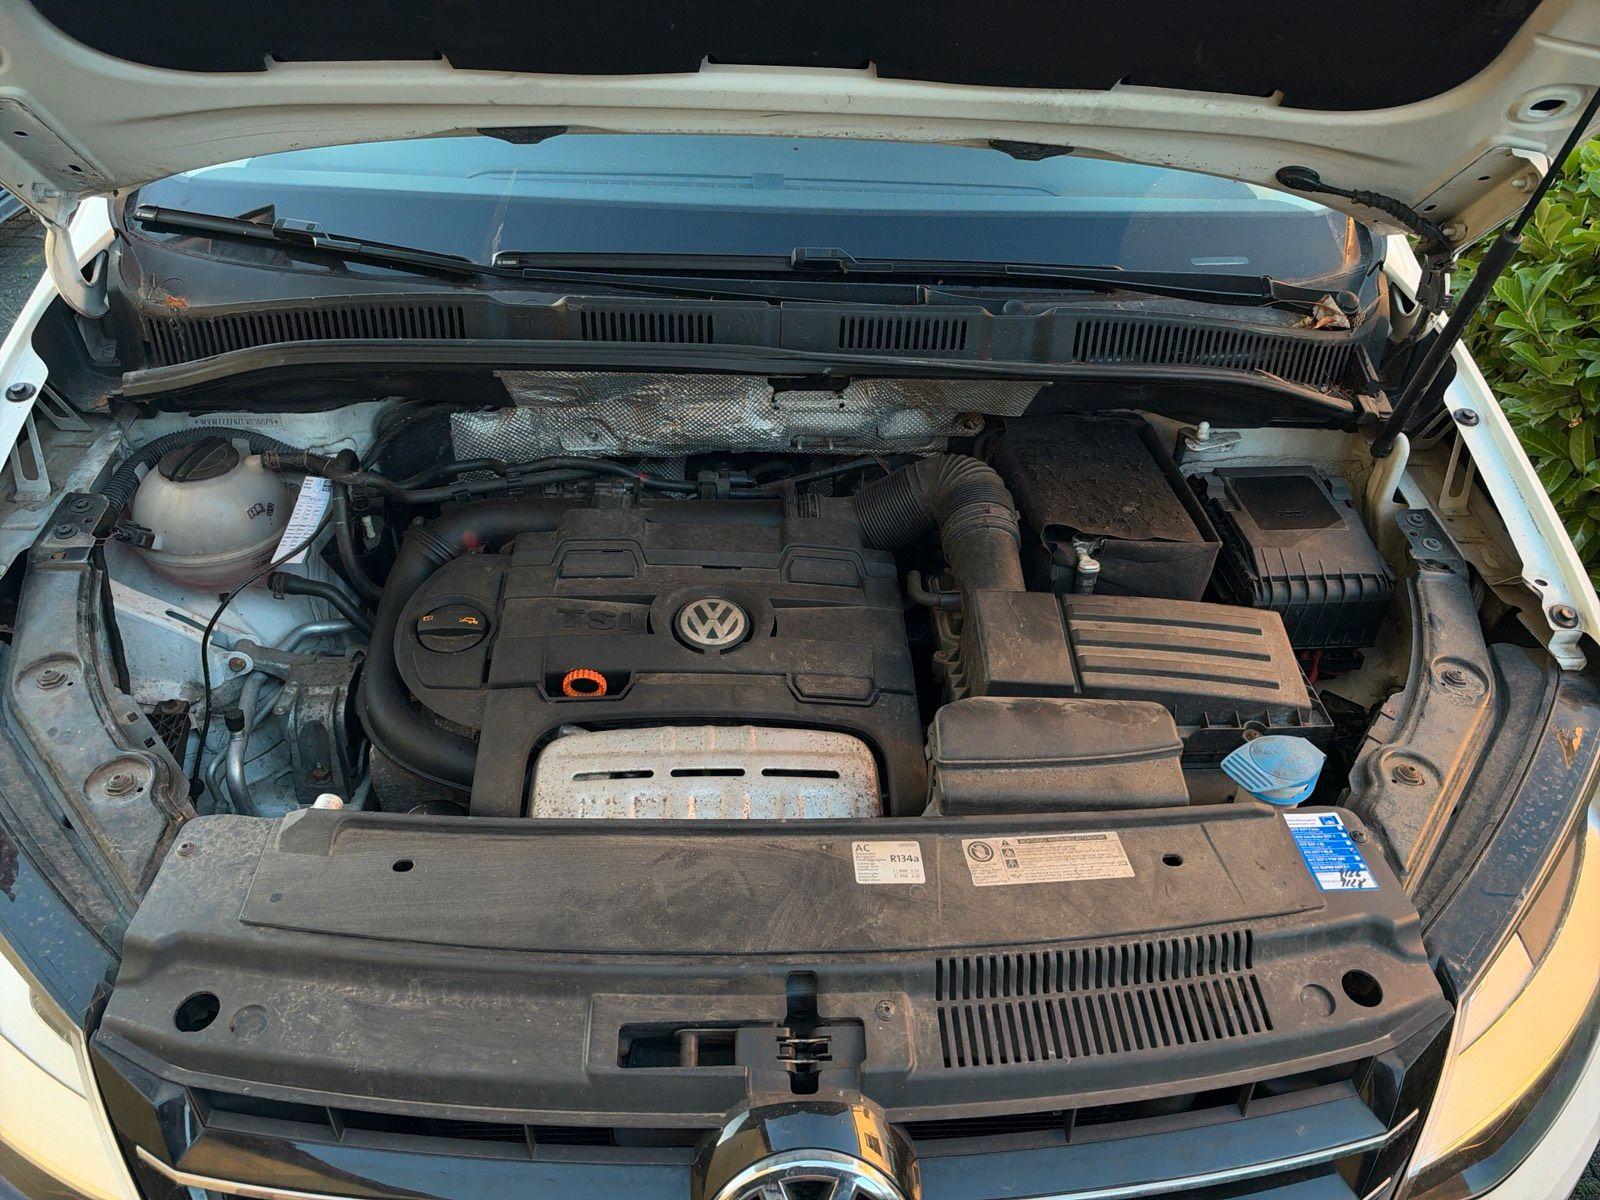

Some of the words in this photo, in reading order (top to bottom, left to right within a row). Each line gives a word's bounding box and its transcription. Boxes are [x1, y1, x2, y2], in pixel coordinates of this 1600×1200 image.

[556, 607, 634, 631] TSI
[855, 844, 871, 852] AC
[889, 854, 920, 863] R134a
